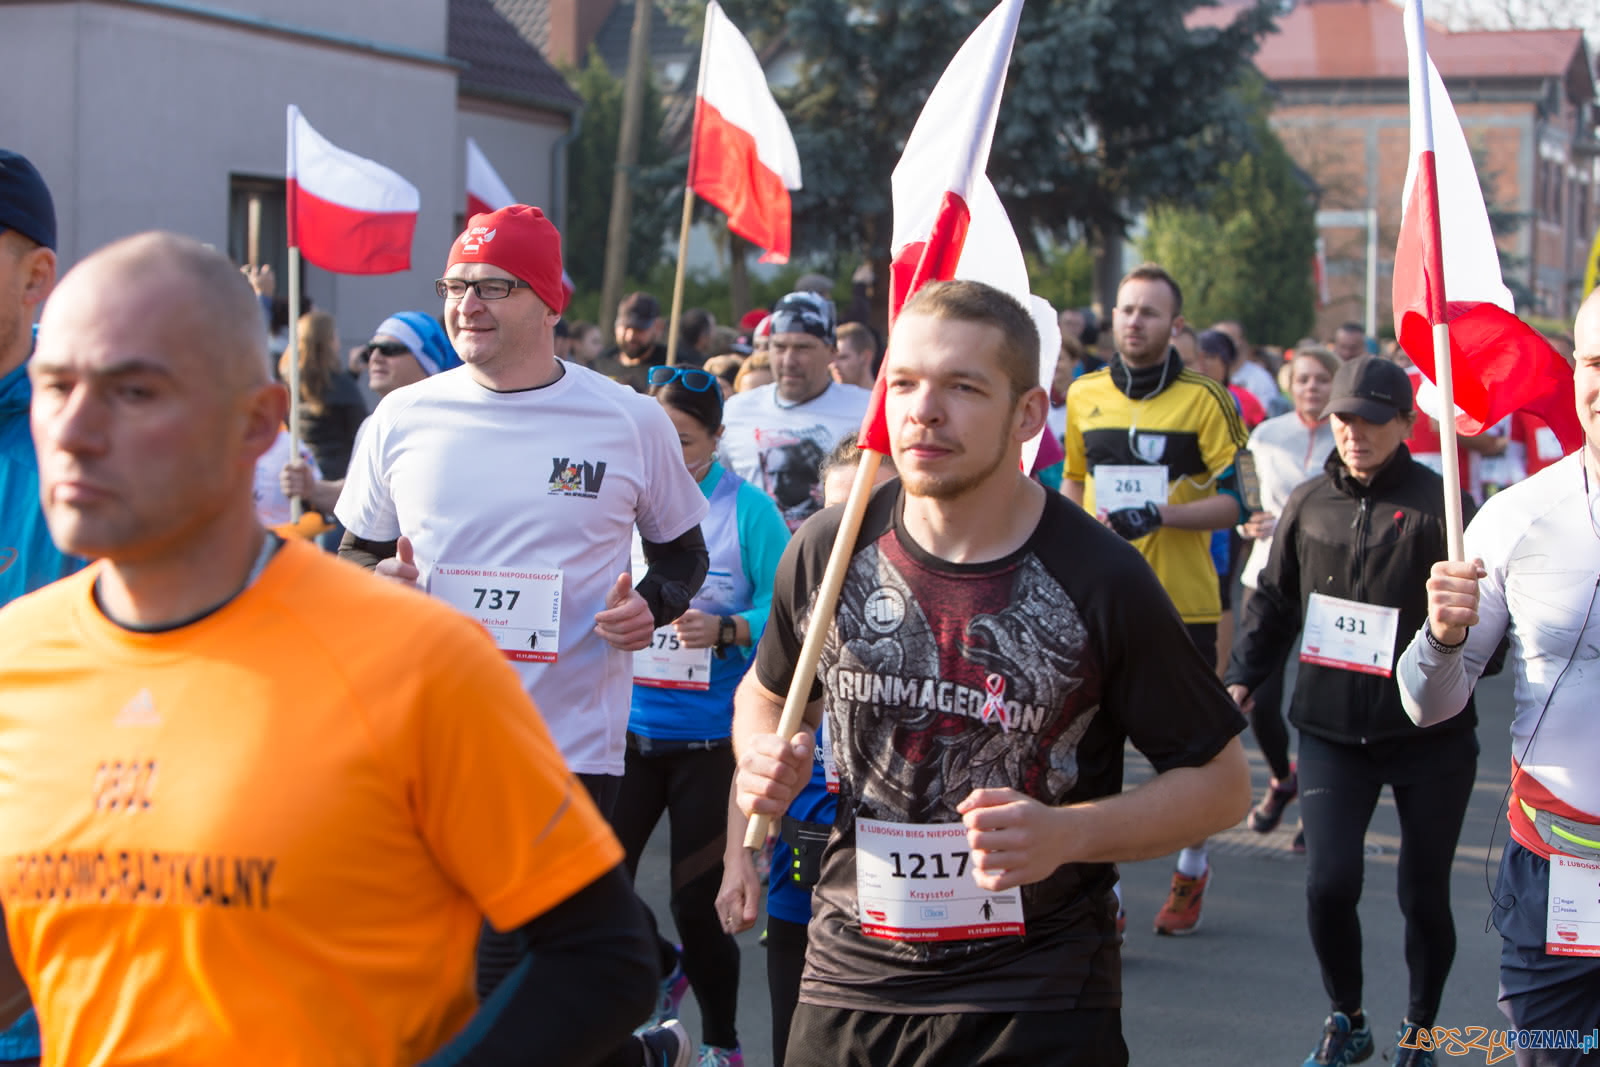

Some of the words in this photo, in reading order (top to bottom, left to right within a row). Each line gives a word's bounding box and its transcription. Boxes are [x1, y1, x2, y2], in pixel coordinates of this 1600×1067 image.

[1115, 480, 1142, 492] 261
[473, 588, 520, 611] 737
[1335, 616, 1367, 635] 431
[649, 633, 680, 650] 75
[838, 670, 1046, 734] RUNMAGEDON
[868, 826, 904, 837] LUBOŃSKI
[890, 851, 969, 879] 1217
[910, 888, 955, 902] Krzysztof
